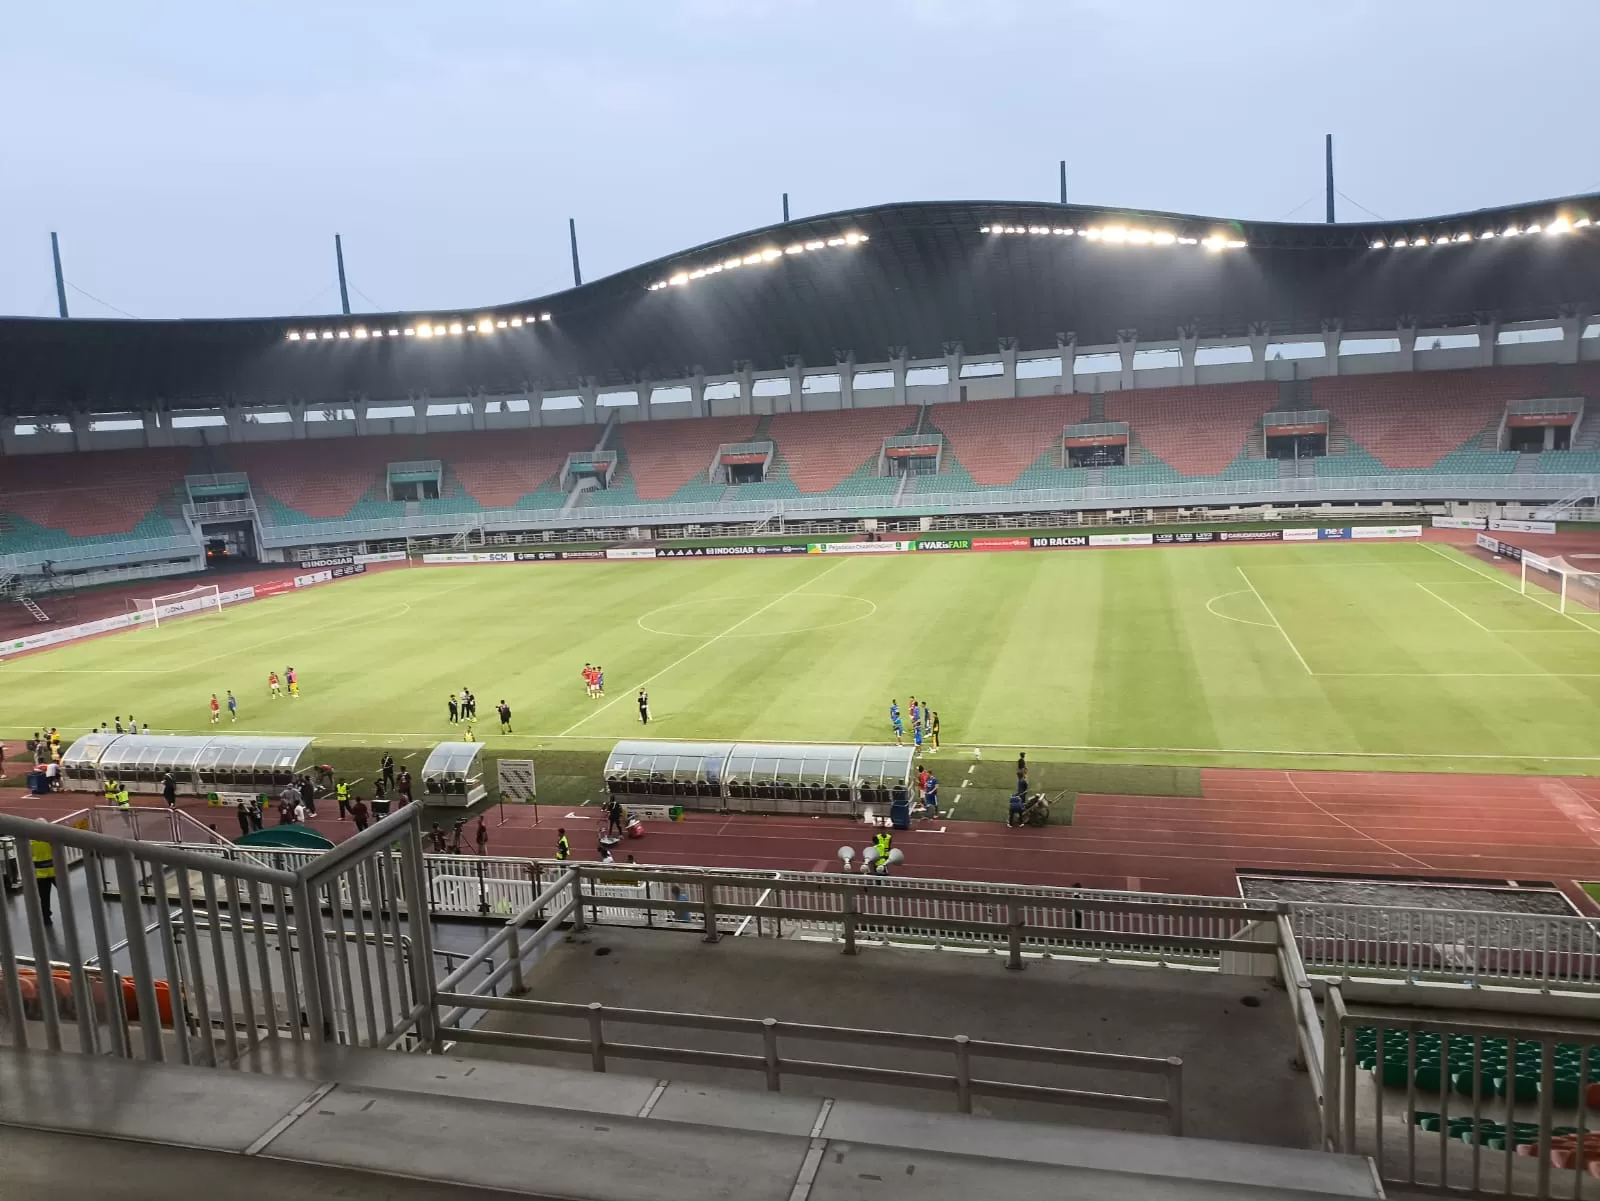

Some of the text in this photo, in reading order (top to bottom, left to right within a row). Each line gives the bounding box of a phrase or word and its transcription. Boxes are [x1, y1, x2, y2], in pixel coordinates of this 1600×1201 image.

[919, 540, 969, 549] #VARisFAIR
[1034, 538, 1048, 546] NO
[1049, 537, 1086, 546] RACISM
[714, 547, 754, 555] INDOSIAR
[311, 557, 353, 568] INDOSIAR
